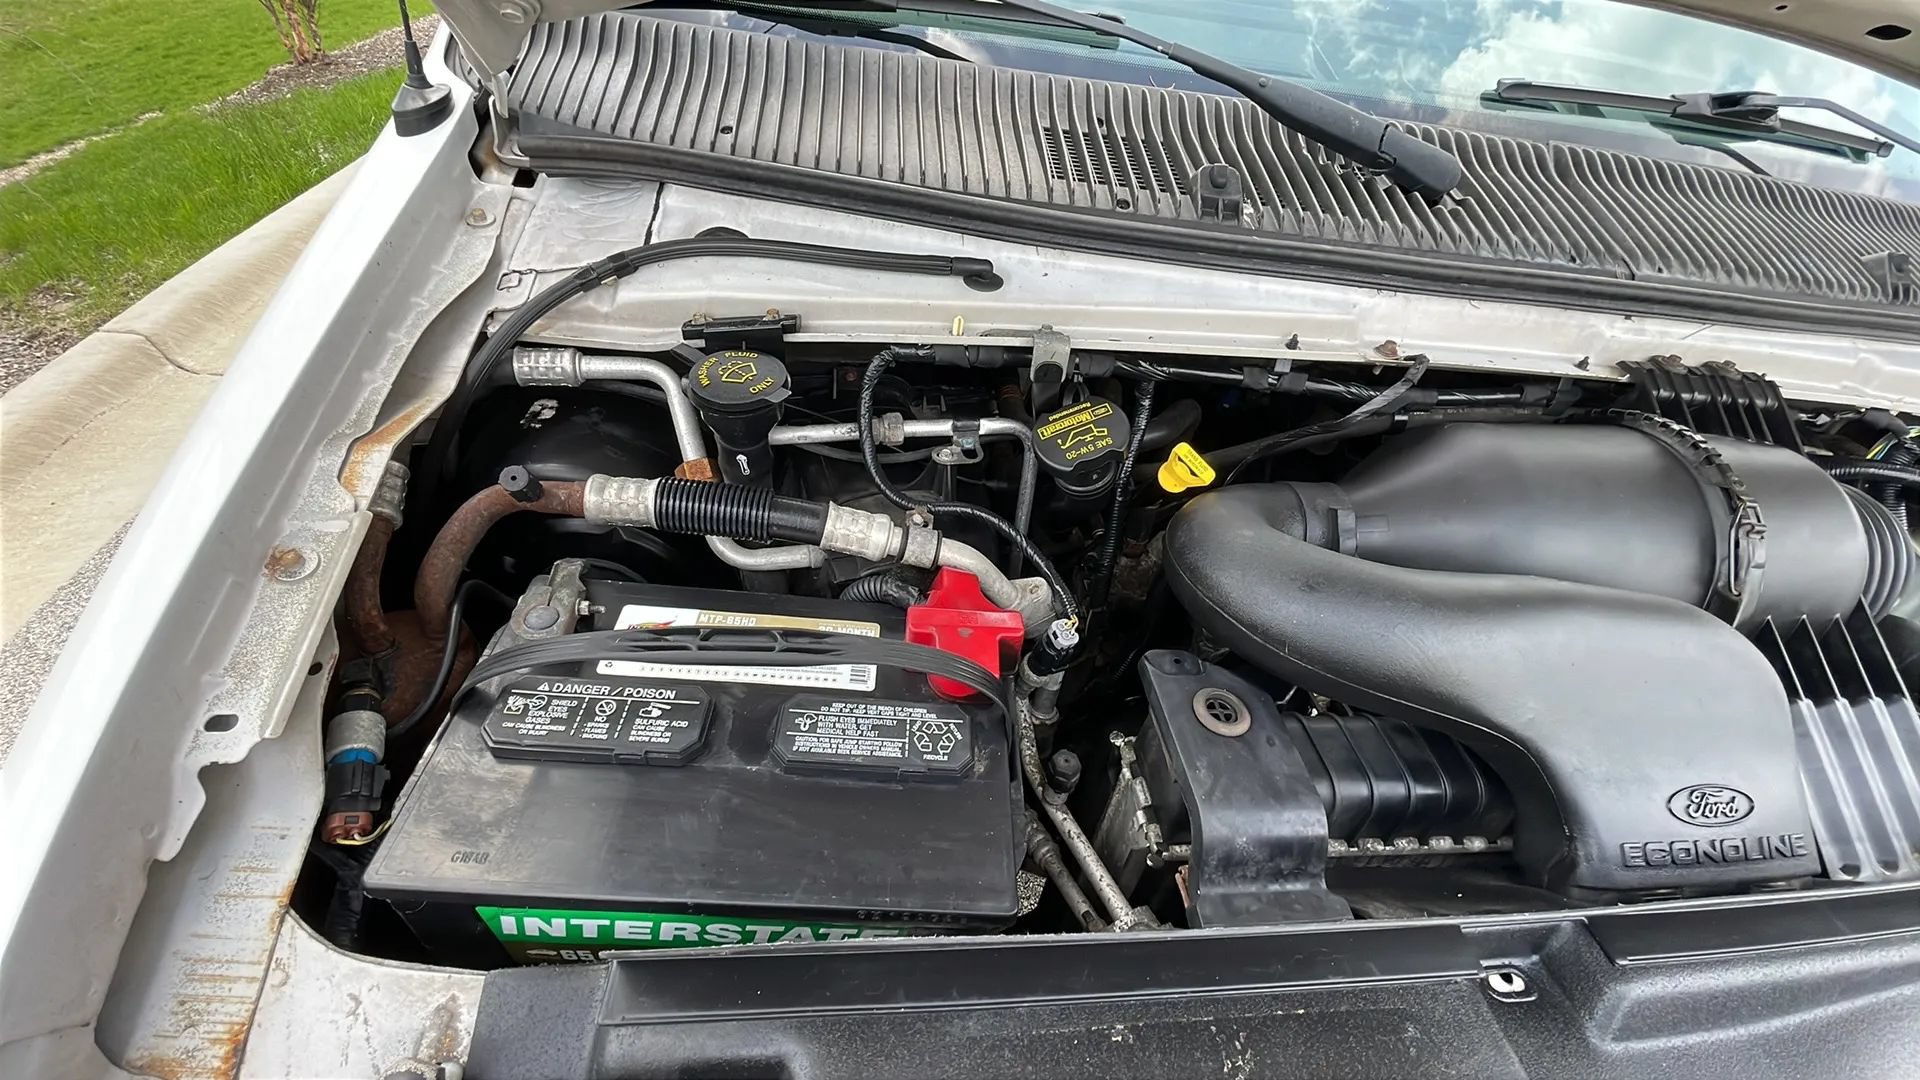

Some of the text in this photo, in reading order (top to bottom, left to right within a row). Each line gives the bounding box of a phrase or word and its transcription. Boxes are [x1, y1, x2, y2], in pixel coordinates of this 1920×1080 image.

[698, 357, 719, 387] WASHER
[749, 377, 775, 394] ONLY
[1048, 402, 1091, 421] Recommended
[1040, 411, 1092, 438] Motorcraft
[1066, 437, 1113, 460] SAE 5W-20
[552, 683, 611, 695] DANGER
[624, 687, 676, 699] POISON
[551, 699, 578, 707] SHIELD
[528, 711, 569, 719] EXPLOSIVE
[634, 718, 670, 727] SULFURIC
[857, 718, 897, 726] IMMEDIATELY
[1686, 787, 1740, 819] Ford
[1620, 833, 1810, 867] ECONOLINE
